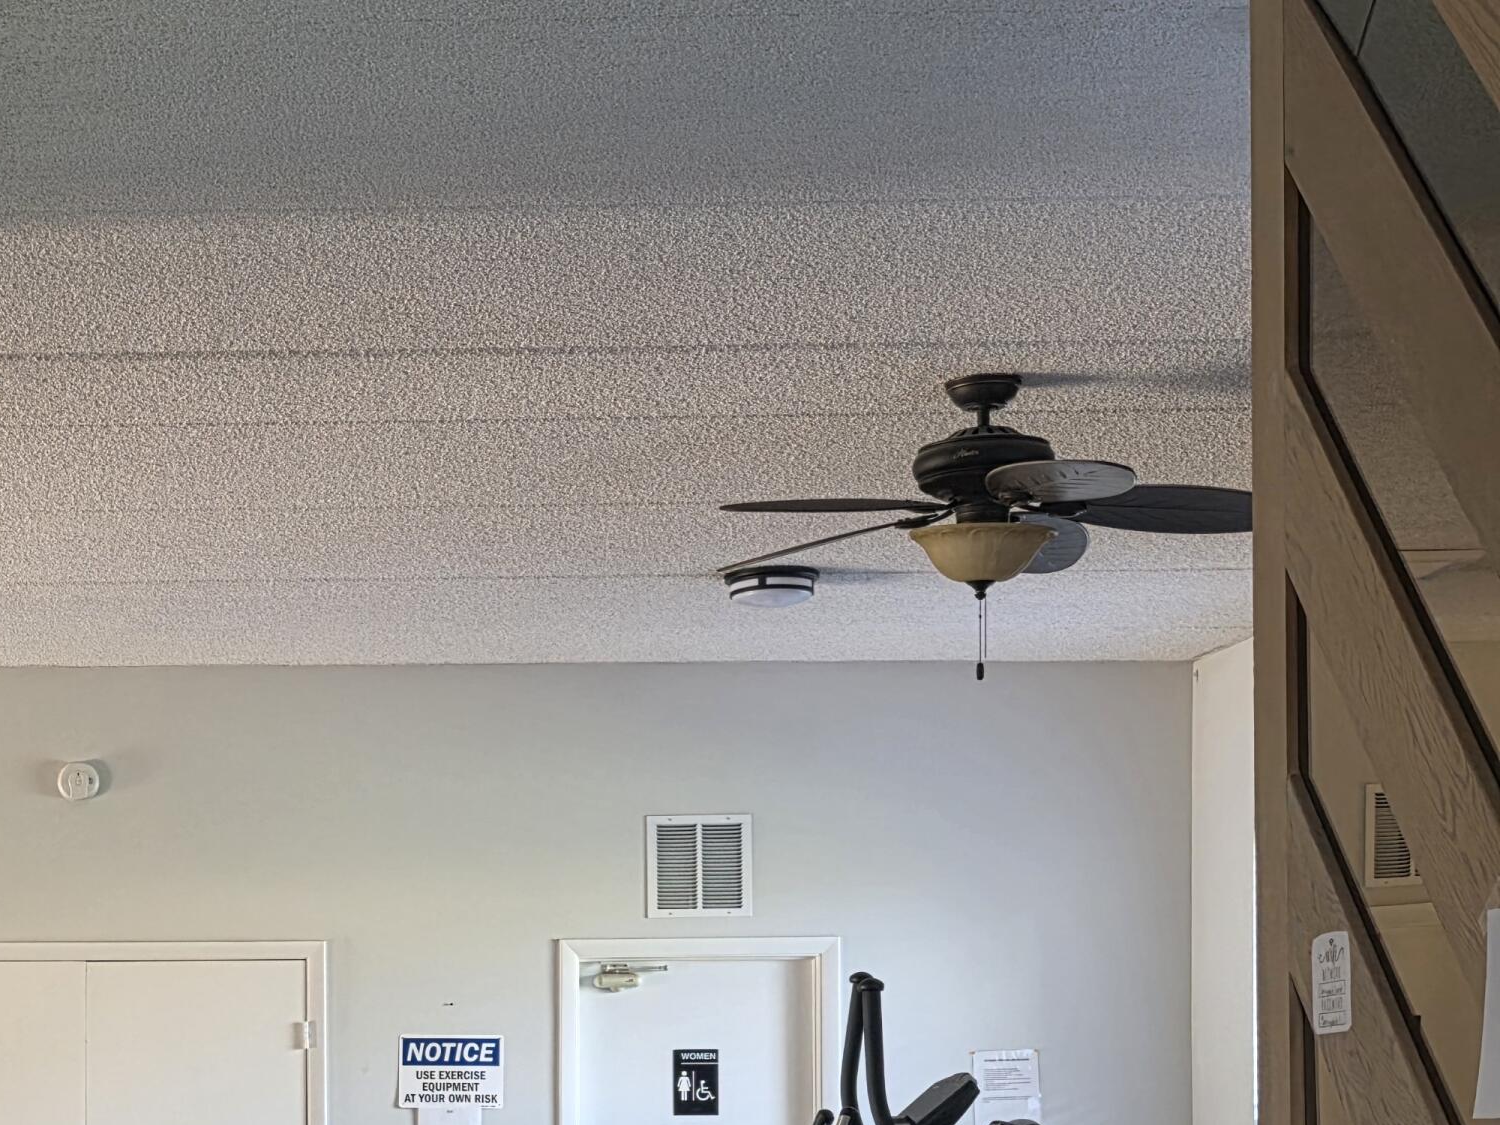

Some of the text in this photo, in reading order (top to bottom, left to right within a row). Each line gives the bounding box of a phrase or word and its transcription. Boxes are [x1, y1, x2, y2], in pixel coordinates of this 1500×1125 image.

[406, 1042, 496, 1062] NOTICE
[680, 1052, 717, 1060] WOMEN
[415, 1070, 486, 1080] USE EXERCISE
[422, 1082, 480, 1093] EQUIPMENT
[404, 1093, 498, 1104] AT YOUR OWN RISK
